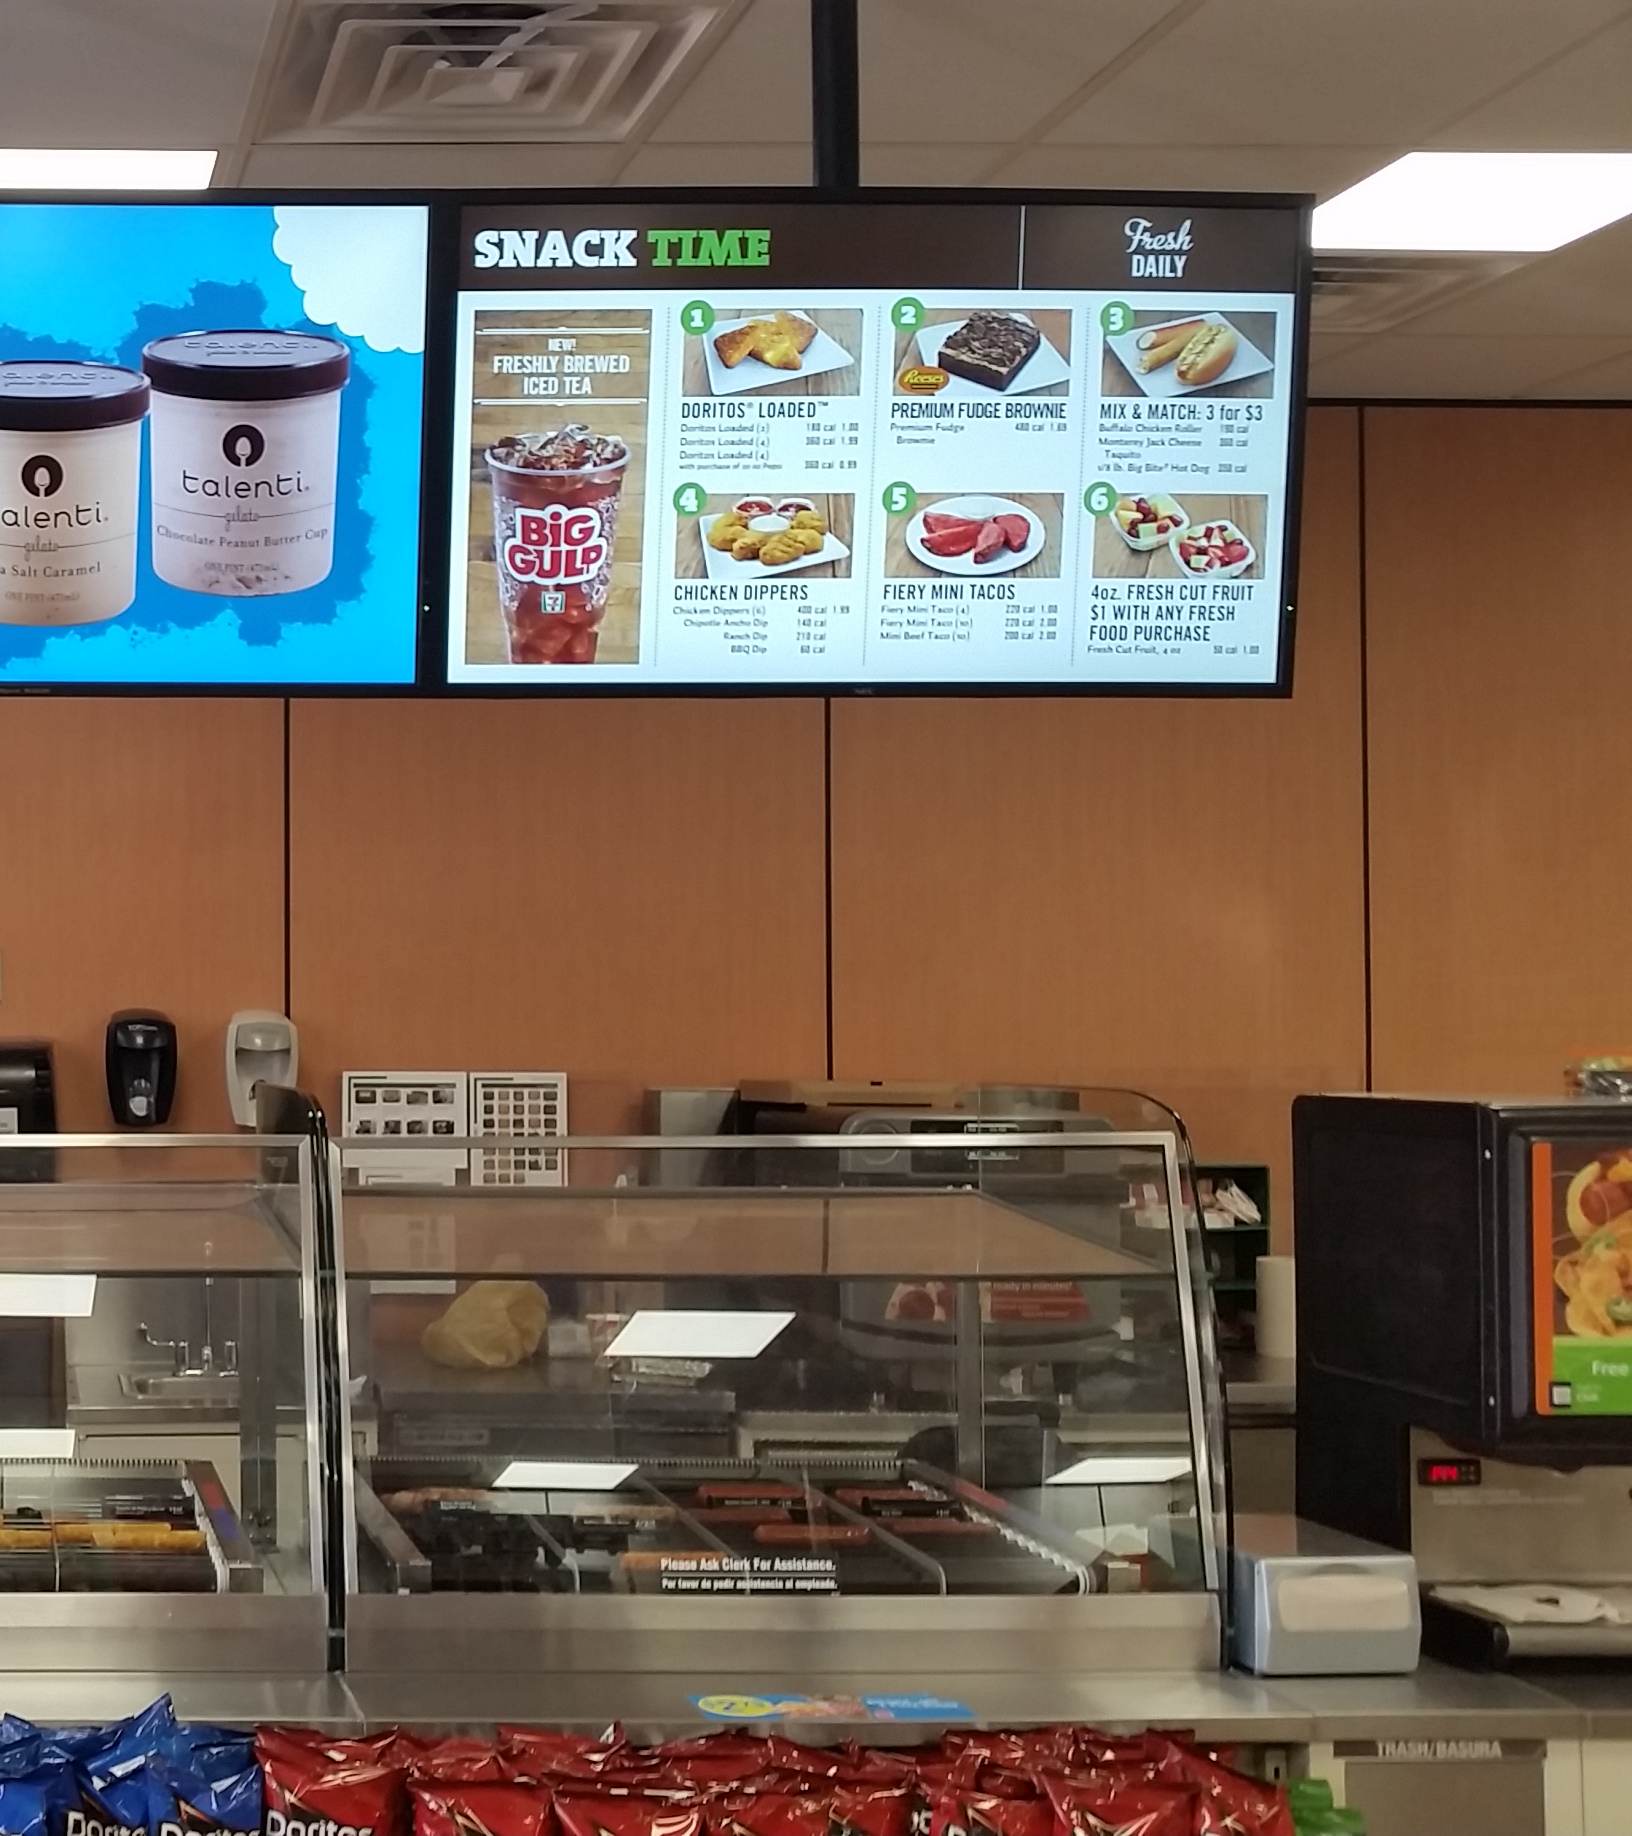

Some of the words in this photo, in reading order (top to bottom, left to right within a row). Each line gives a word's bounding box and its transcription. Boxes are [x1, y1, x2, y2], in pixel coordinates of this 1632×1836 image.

[1124, 218, 1194, 253] Fresh
[474, 230, 638, 268] SNACK
[647, 230, 771, 267] TIME
[1131, 255, 1187, 277] DAILY
[690, 309, 704, 327] 1
[900, 306, 916, 324] 2
[1109, 308, 1123, 331] 3
[493, 356, 560, 374] FRESHLY
[564, 355, 630, 373] BREWED
[523, 377, 558, 395] ICED
[564, 377, 592, 394] TEA
[891, 403, 954, 418] PREMIUM
[958, 403, 1001, 418] FUDGE
[1005, 403, 1066, 419] BROWNIE
[1100, 404, 1126, 419] MIX
[1132, 404, 1142, 419] &
[1206, 405, 1214, 420] 3
[1245, 405, 1263, 421] $3
[679, 489, 698, 512] 4
[891, 487, 906, 511] 5
[1091, 488, 1109, 511] 6
[12, 563, 38, 577] Salt
[43, 561, 101, 578] Caramel
[508, 545, 602, 578] GULP
[674, 585, 738, 600] CHICKEN
[744, 585, 809, 600] DIPPERS
[884, 585, 926, 599] FIERY
[932, 585, 963, 599] MINI
[970, 585, 1015, 600] TACOS
[1128, 585, 1174, 600] FRESH
[1180, 585, 1207, 600] CUT
[1212, 585, 1254, 601] FRUIT
[1091, 605, 1105, 620] $1
[1113, 605, 1150, 620] WITH
[1155, 606, 1183, 621] ANY
[1189, 606, 1235, 621] FRESH
[1089, 626, 1128, 641] FOOD
[1134, 626, 1210, 641] PURCHASE
[660, 1558, 697, 1571] Please
[700, 1558, 719, 1571] Ask
[722, 1557, 750, 1571] Clerk
[753, 1558, 770, 1571] For
